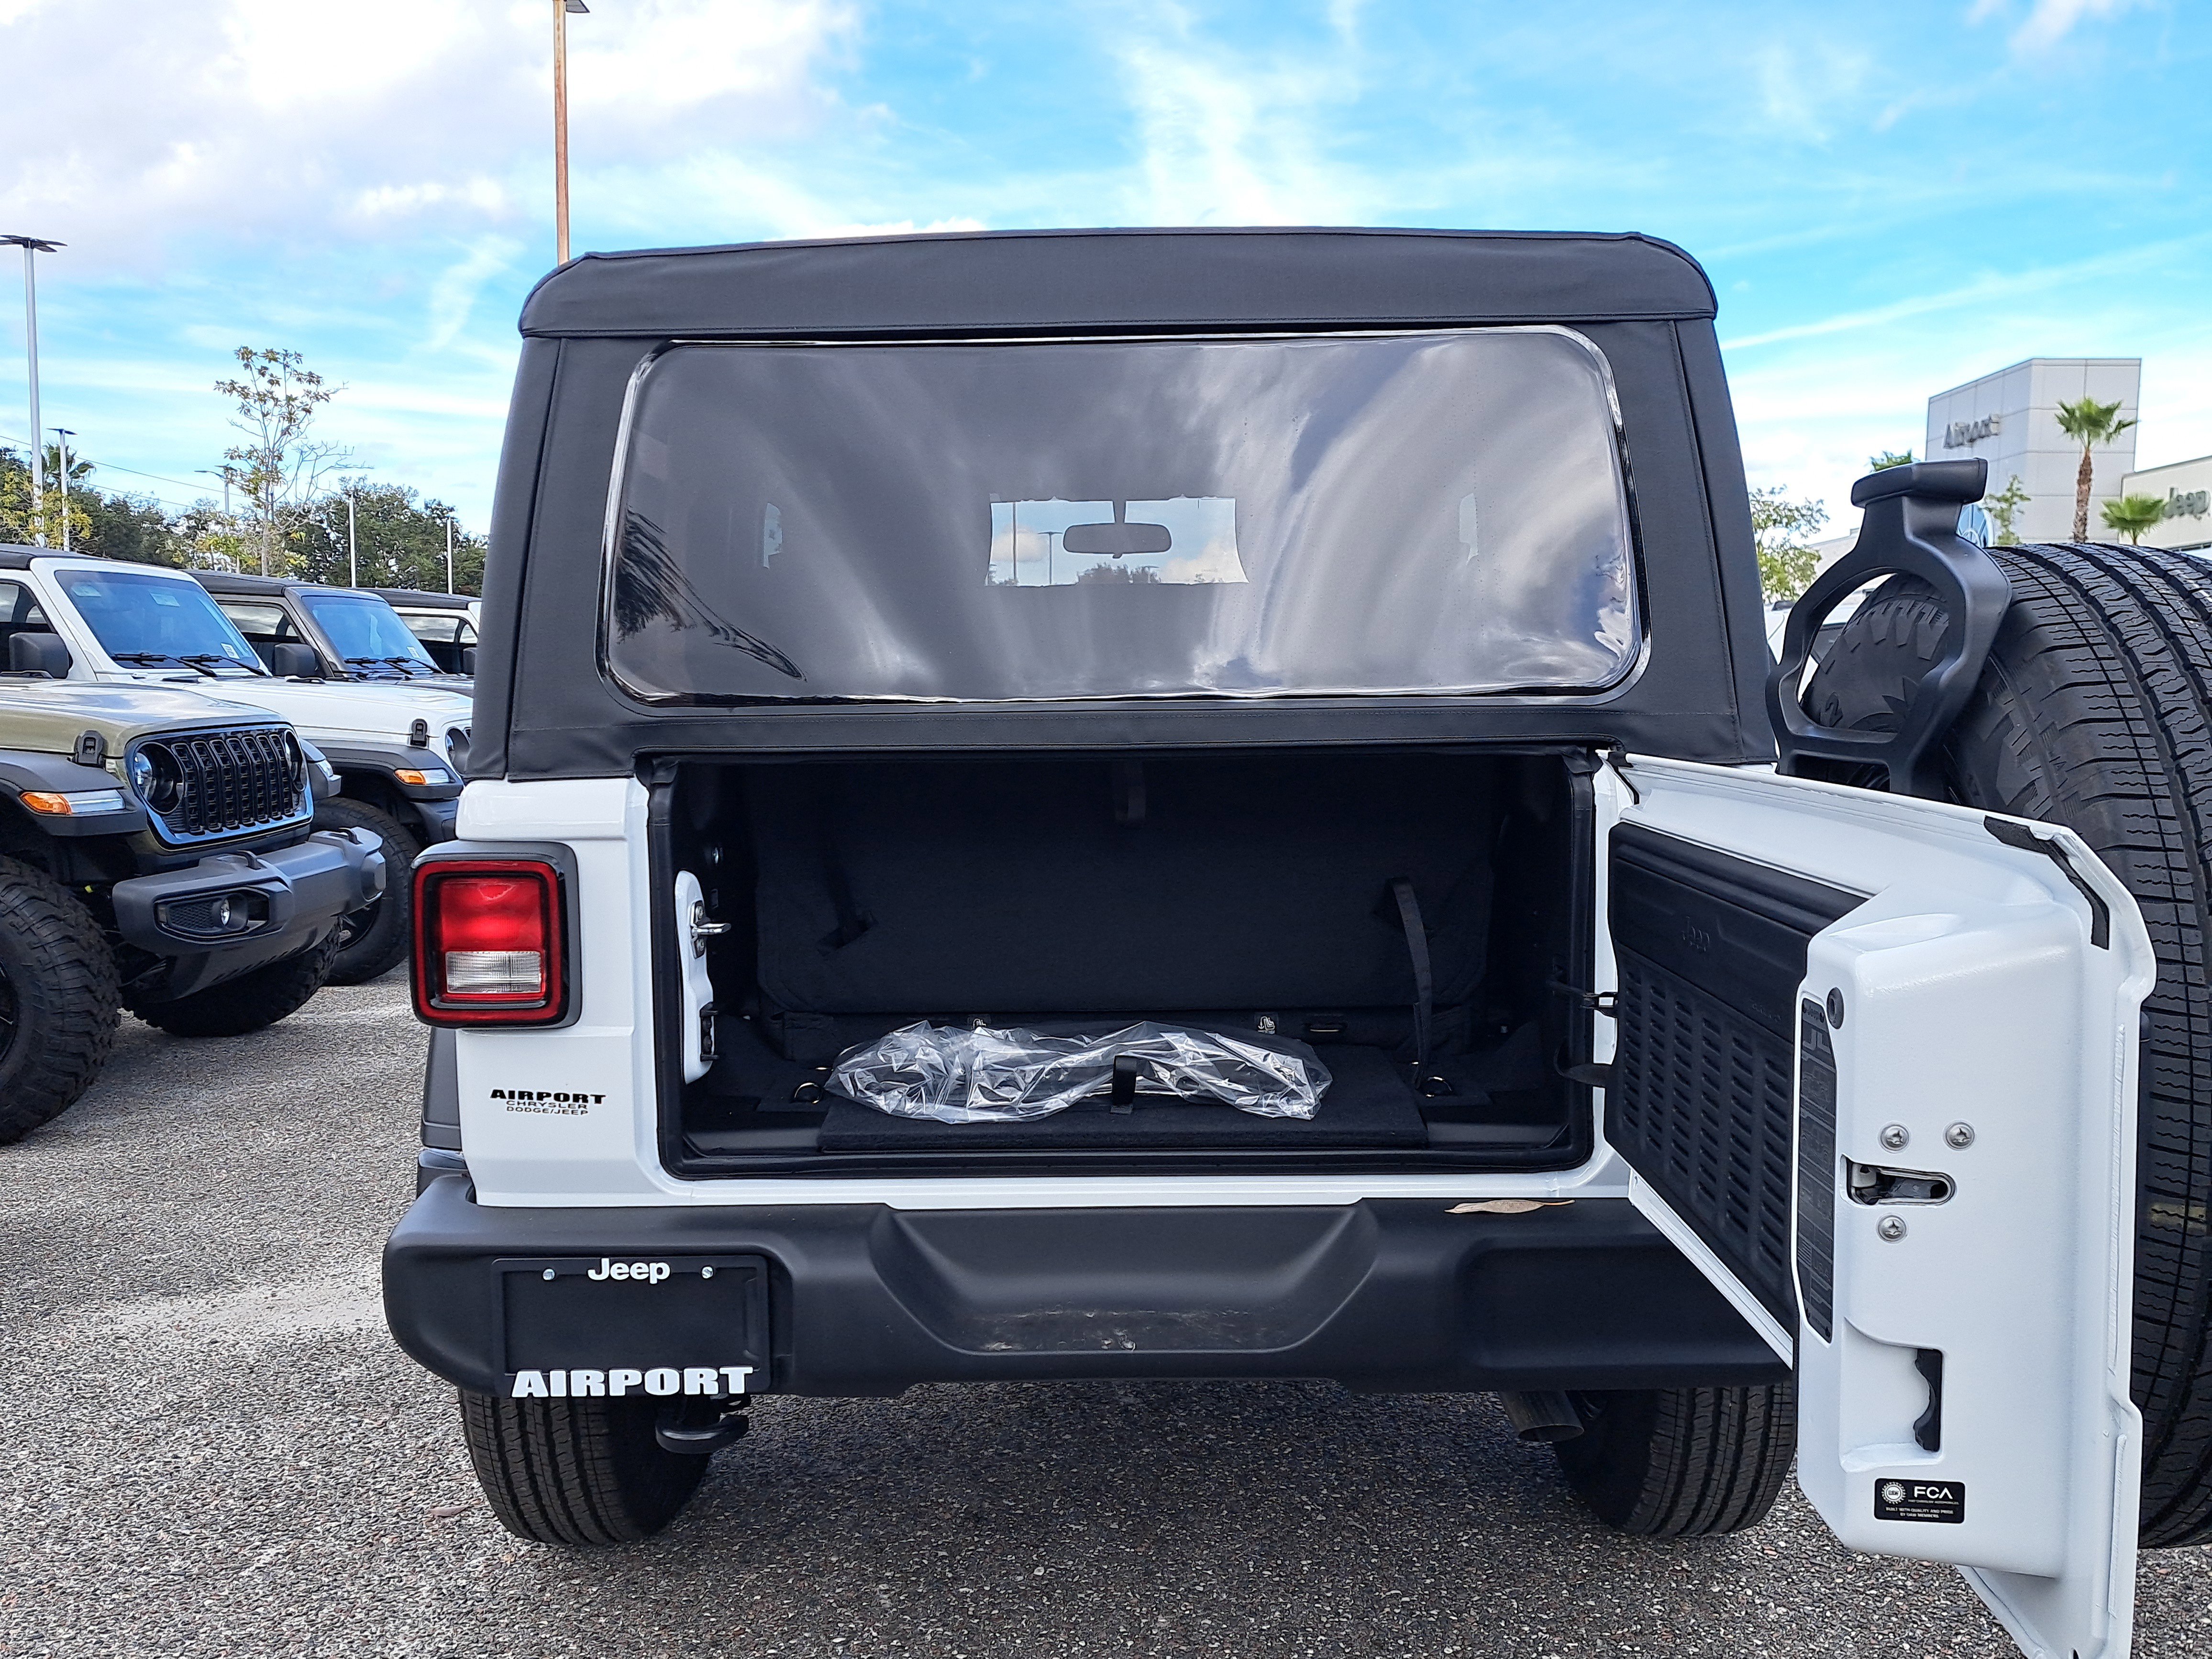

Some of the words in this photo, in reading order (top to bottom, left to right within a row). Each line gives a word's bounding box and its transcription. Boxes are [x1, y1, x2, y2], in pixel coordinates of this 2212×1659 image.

[489, 1089, 606, 1104] AIRPORT
[506, 1100, 588, 1109] CHRYSLER
[507, 1106, 588, 1116] DODGE/JEEP
[587, 1258, 670, 1284] Jeep
[511, 1367, 753, 1397] AIRPORT
[1914, 1486, 1953, 1499] FCA
